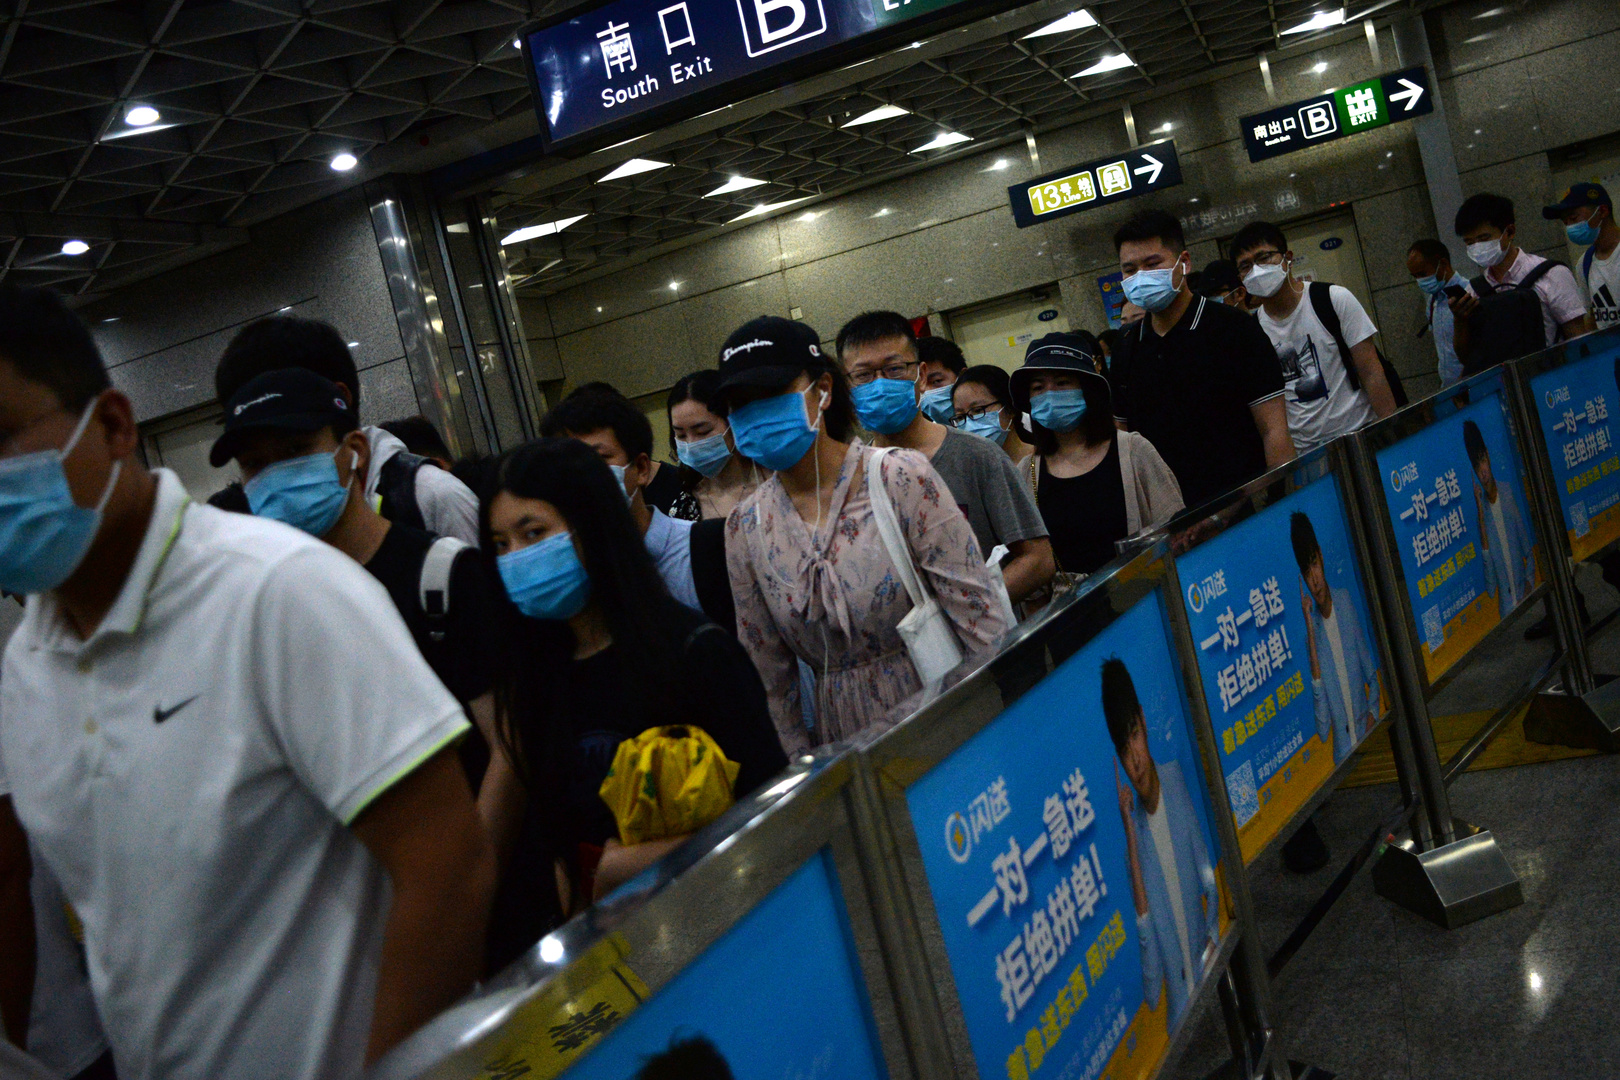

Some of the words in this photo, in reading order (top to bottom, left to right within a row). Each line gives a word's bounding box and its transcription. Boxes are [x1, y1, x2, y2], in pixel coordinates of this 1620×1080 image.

[601, 74, 659, 109] South
[670, 56, 713, 85] Exit
[1253, 116, 1297, 141] 南出口
[1306, 107, 1330, 134] B
[1349, 110, 1378, 127] EXIT
[1063, 192, 1082, 204] Line
[1081, 188, 1093, 198] 13
[1552, 394, 1609, 434] 一对一急送
[1400, 468, 1461, 523] 一对一急送
[1200, 568, 1228, 604] 闪送
[1200, 575, 1285, 652] 一对一急送
[968, 775, 1011, 845] 闪送
[966, 767, 1096, 928] 一对一急送
